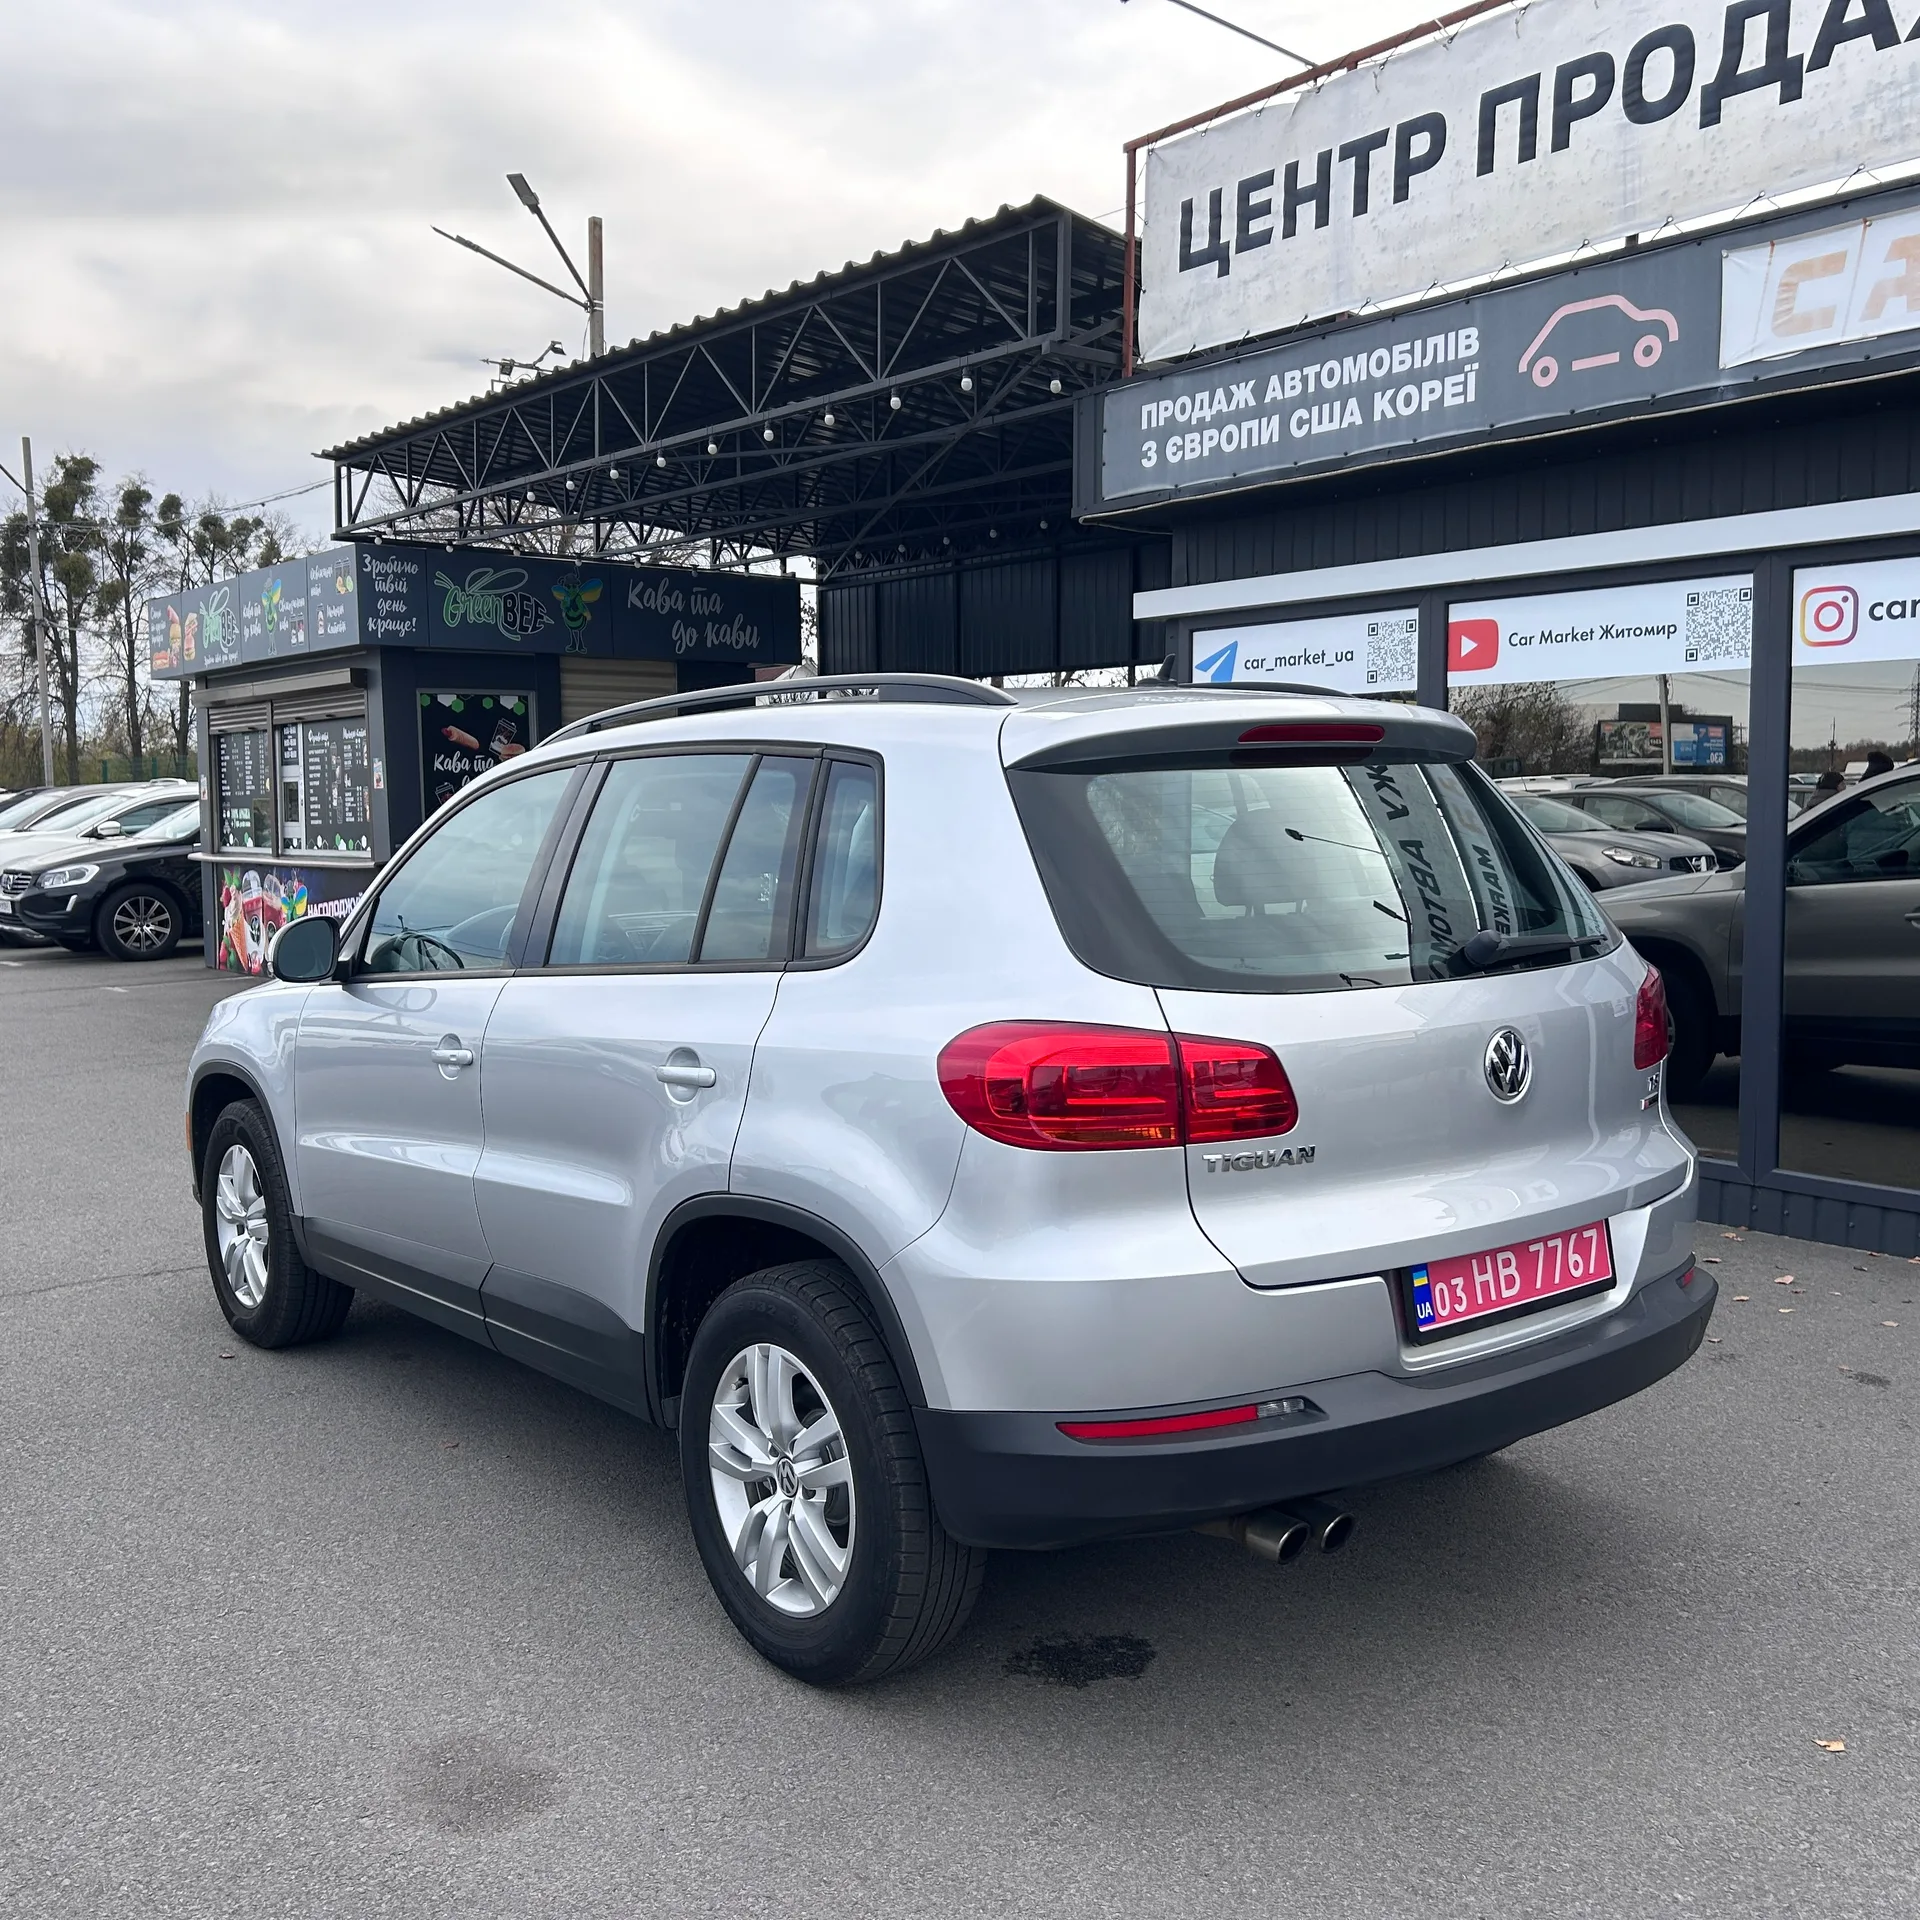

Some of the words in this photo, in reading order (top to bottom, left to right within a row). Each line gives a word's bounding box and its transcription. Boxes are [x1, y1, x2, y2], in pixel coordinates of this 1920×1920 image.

[1178, 111, 1447, 278] ЦЕНТР
[1476, 0, 1920, 177] ПРОДА
[1140, 381, 1257, 430] ПРОДАЖ
[1264, 327, 1480, 404] АВТОМОБІЛІВ
[1140, 441, 1157, 468] З
[1165, 417, 1280, 463] ЄВРОПИ
[1291, 401, 1367, 438] США
[1372, 364, 1479, 423] КОРЕЇ
[362, 553, 418, 576] Зробимо
[375, 574, 408, 594] твій
[628, 577, 685, 614] Кава
[691, 587, 724, 615] та
[377, 597, 408, 617] день
[367, 615, 416, 638] краще!
[672, 619, 698, 654] до
[704, 616, 760, 649] кави
[1508, 631, 1534, 648] Car
[1539, 624, 1594, 645] Market
[1598, 619, 1678, 642] Житомир
[1244, 647, 1354, 673] car_market_ua
[434, 751, 470, 773] Кава
[1202, 1145, 1315, 1173] TIGUAN
[1435, 1276, 1468, 1316] 03
[1471, 1252, 1521, 1305] HB
[1528, 1228, 1598, 1291] 7767
[1416, 1302, 1433, 1320] UA
